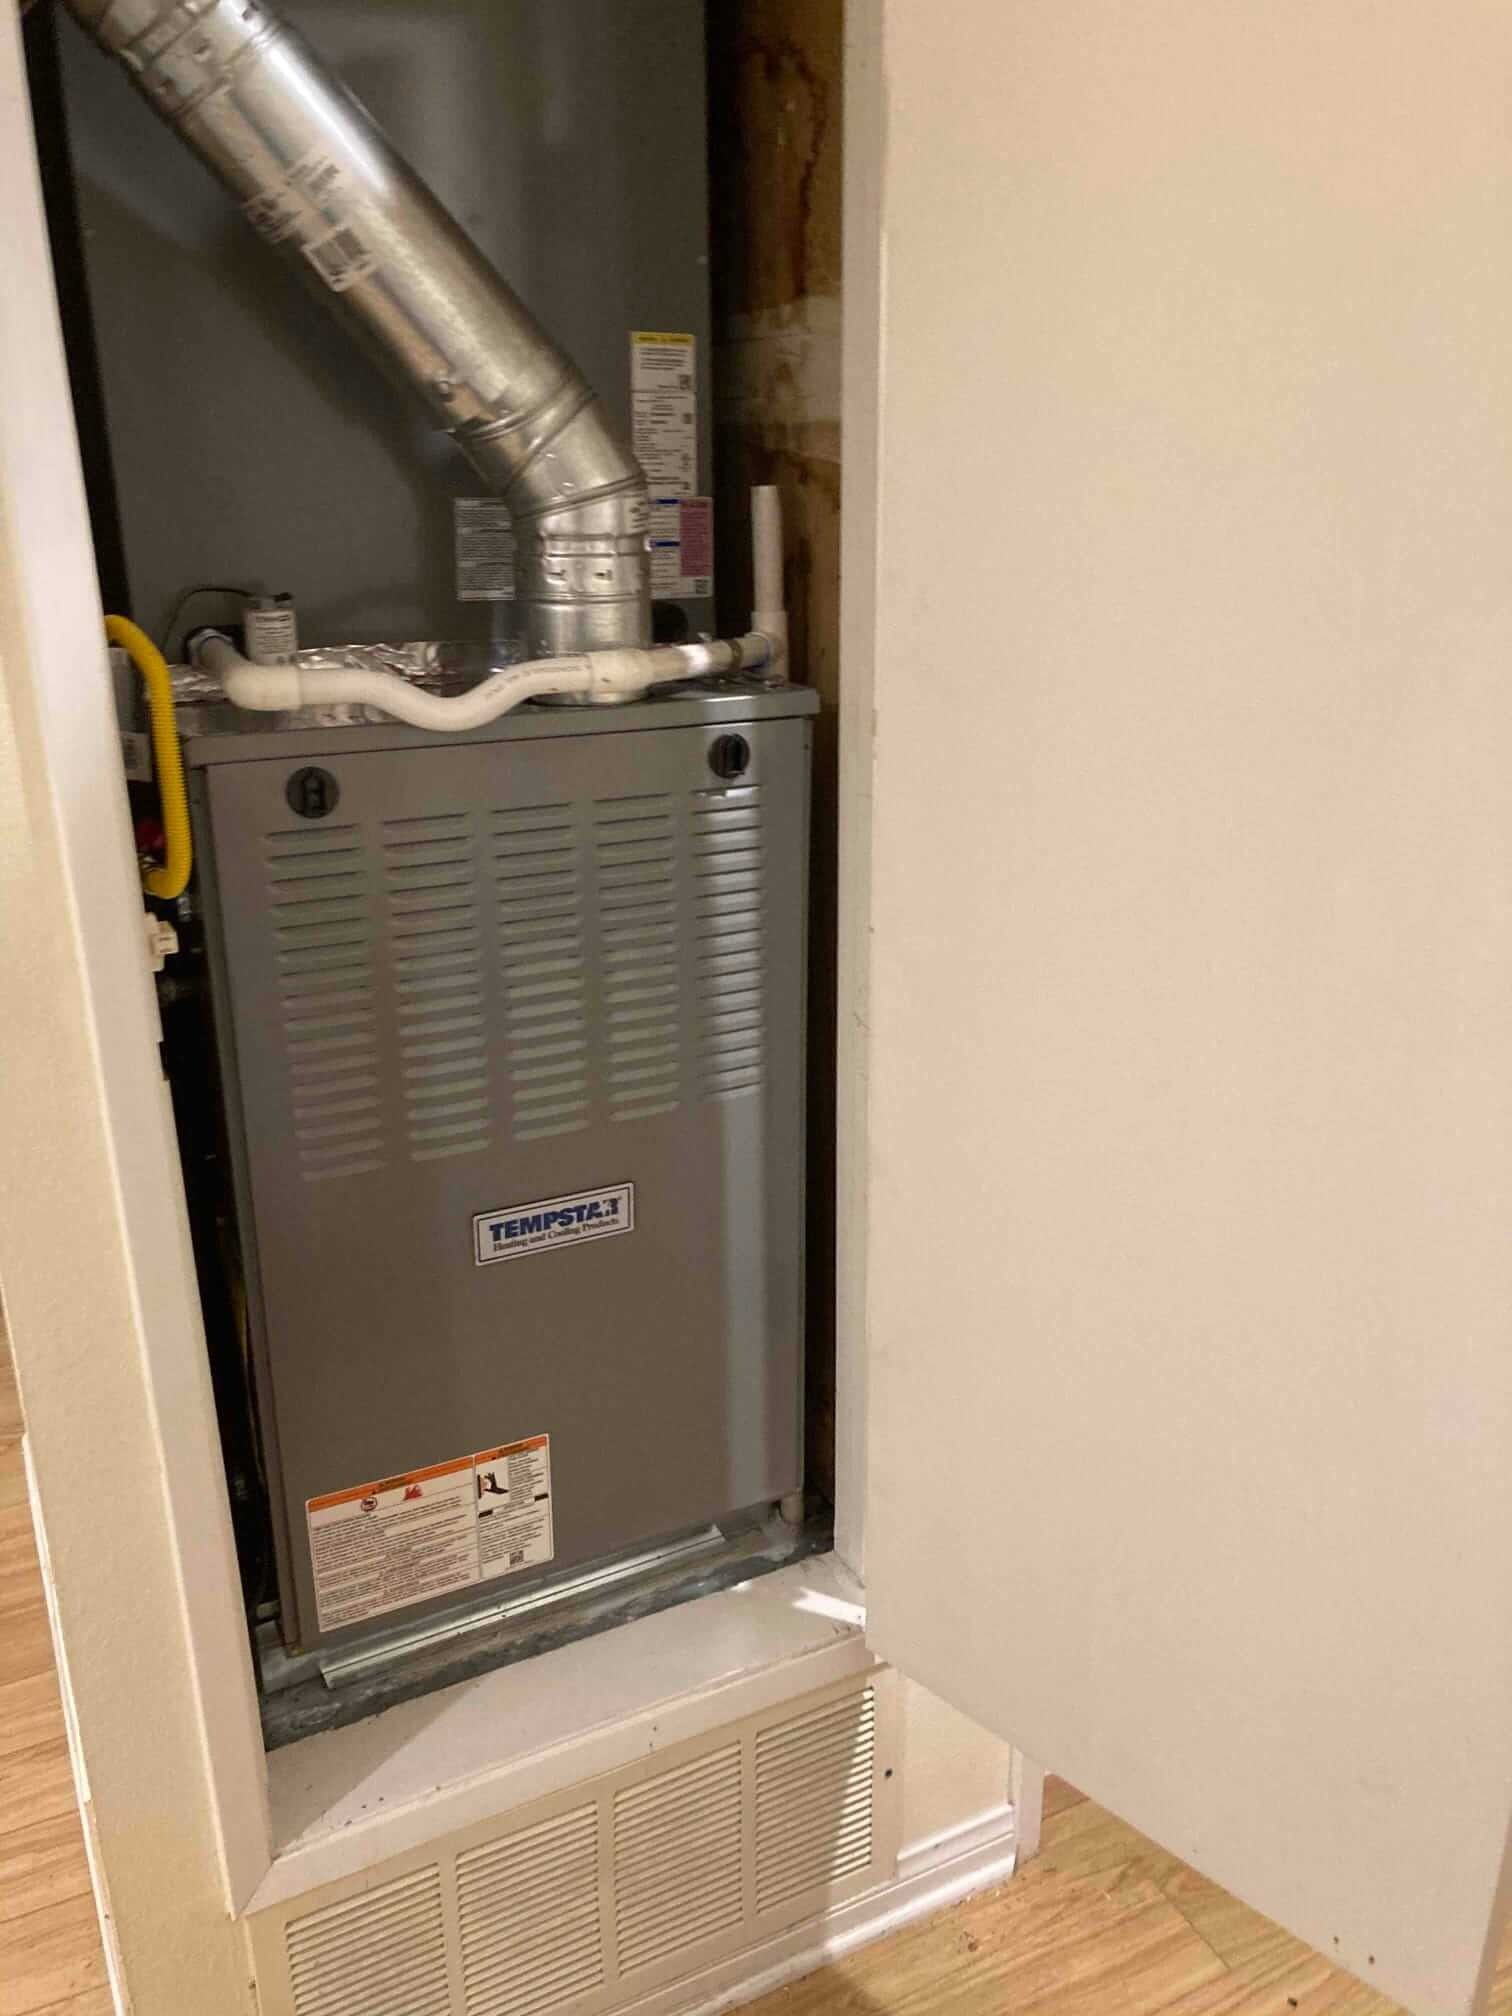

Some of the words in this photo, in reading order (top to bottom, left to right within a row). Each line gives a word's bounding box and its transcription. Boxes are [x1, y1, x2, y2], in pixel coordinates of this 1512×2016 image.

[489, 1198, 620, 1242] TEMPSTAR
[493, 1238, 528, 1252] Heating
[529, 1232, 546, 1244] and
[547, 1227, 580, 1240] Cooling
[582, 1218, 619, 1232] Products
